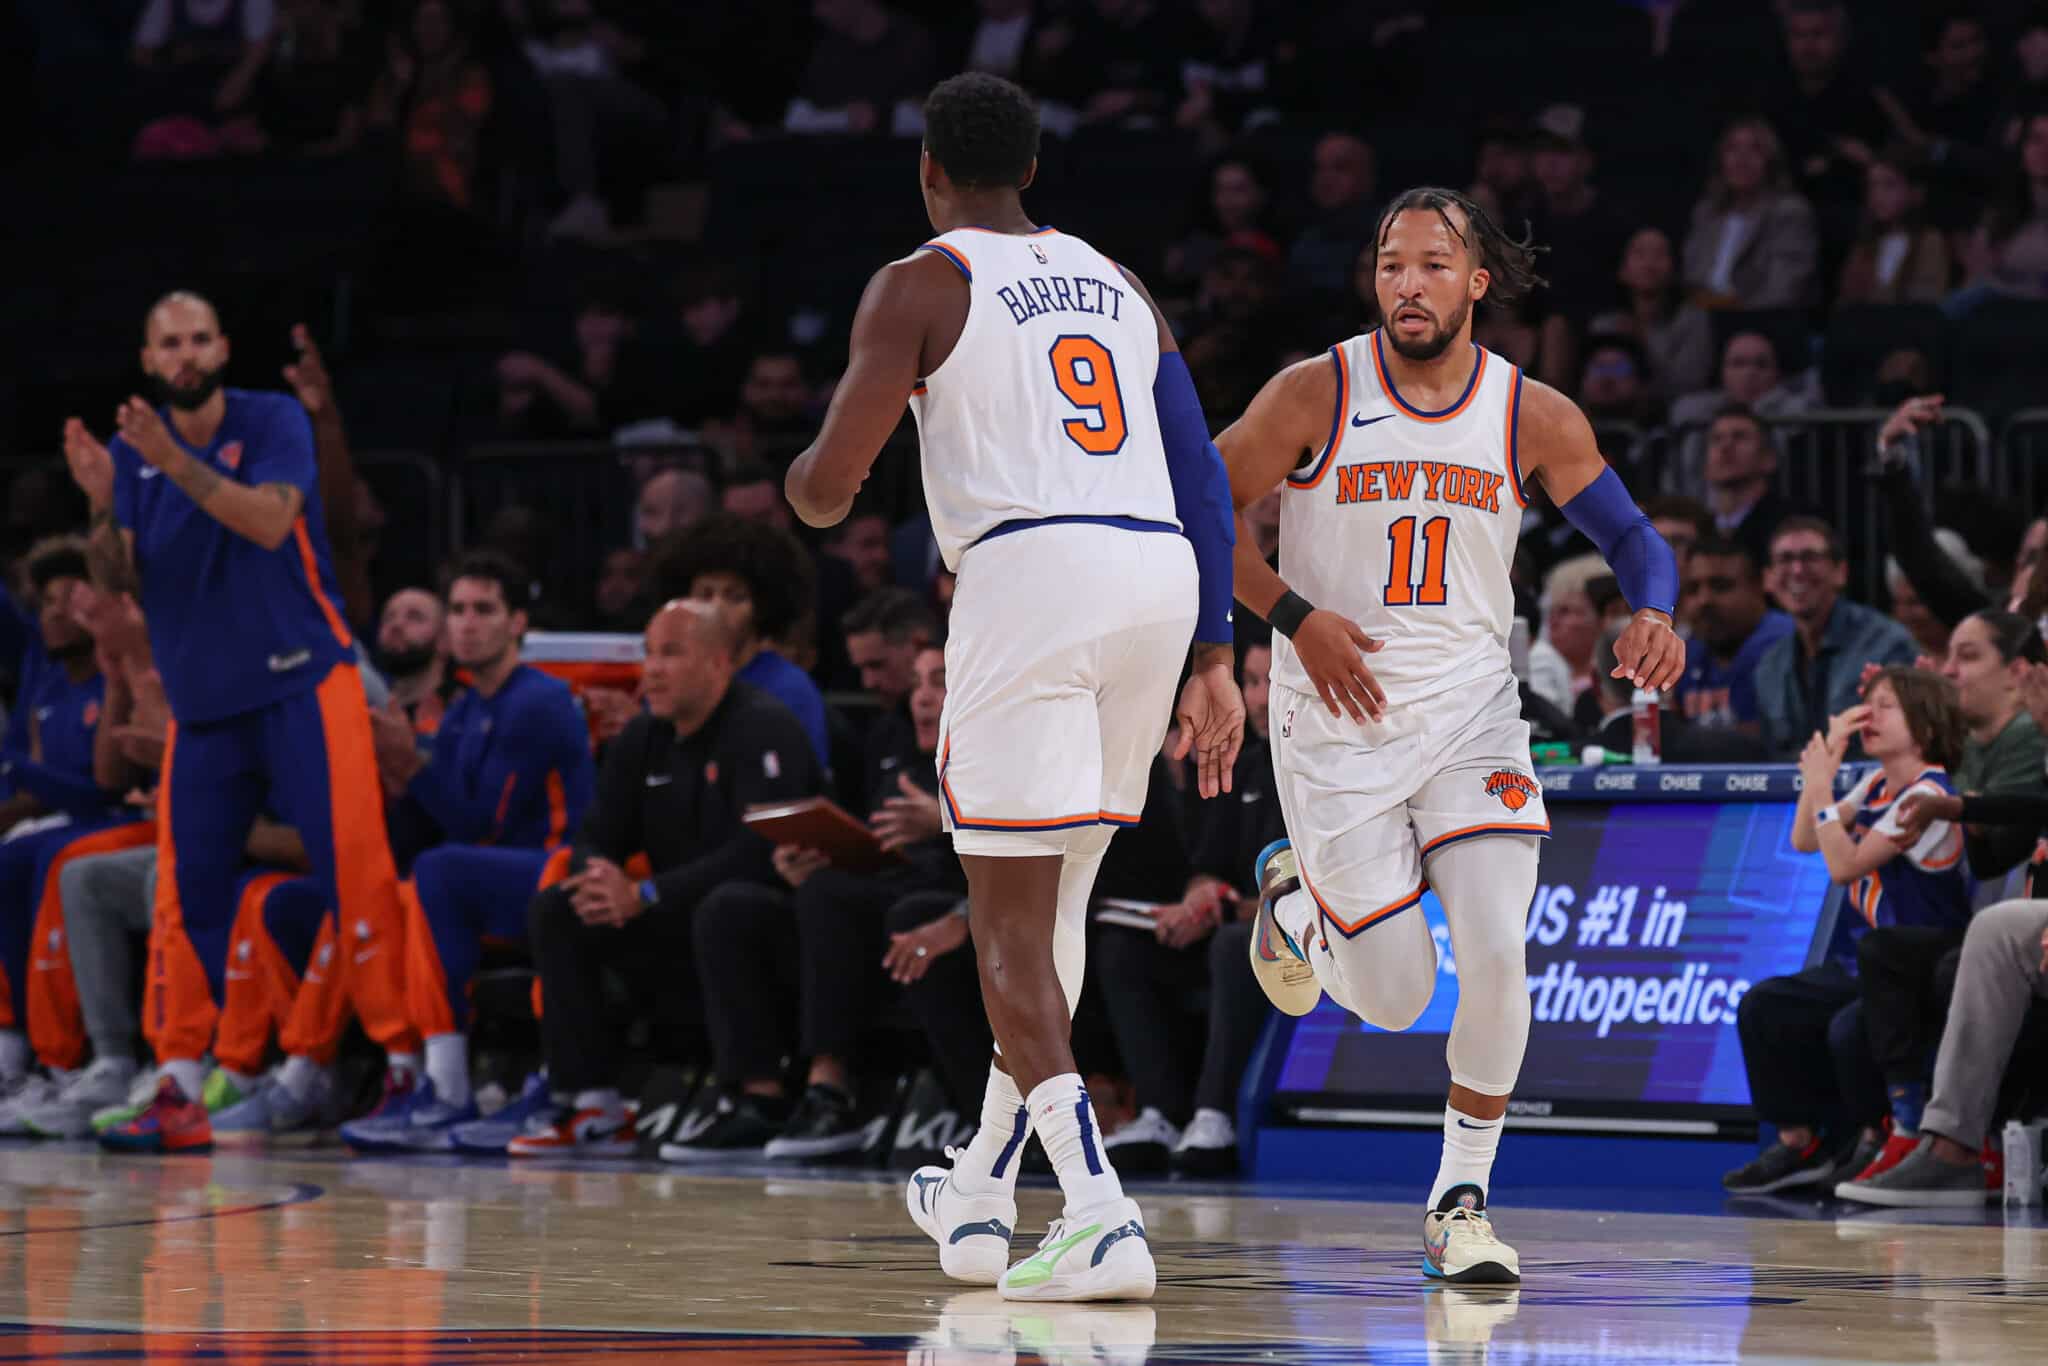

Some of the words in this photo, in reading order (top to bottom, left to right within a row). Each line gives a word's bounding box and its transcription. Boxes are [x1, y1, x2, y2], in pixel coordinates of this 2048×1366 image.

[997, 276, 1124, 325] BARRETT
[1048, 334, 1129, 456] 9
[1336, 461, 1418, 504] NEW
[1421, 461, 1504, 514] YORK
[1383, 515, 1451, 606] 11
[1485, 771, 1540, 798] KNICKS
[1540, 774, 1572, 790] HASE
[1595, 774, 1637, 790] CHASE
[1660, 774, 1702, 791] CHASE
[1726, 774, 1769, 791] CHASE
[1578, 886, 1638, 946] #1
[1640, 886, 1688, 946] in
[1526, 961, 1751, 1037] rthopedics
